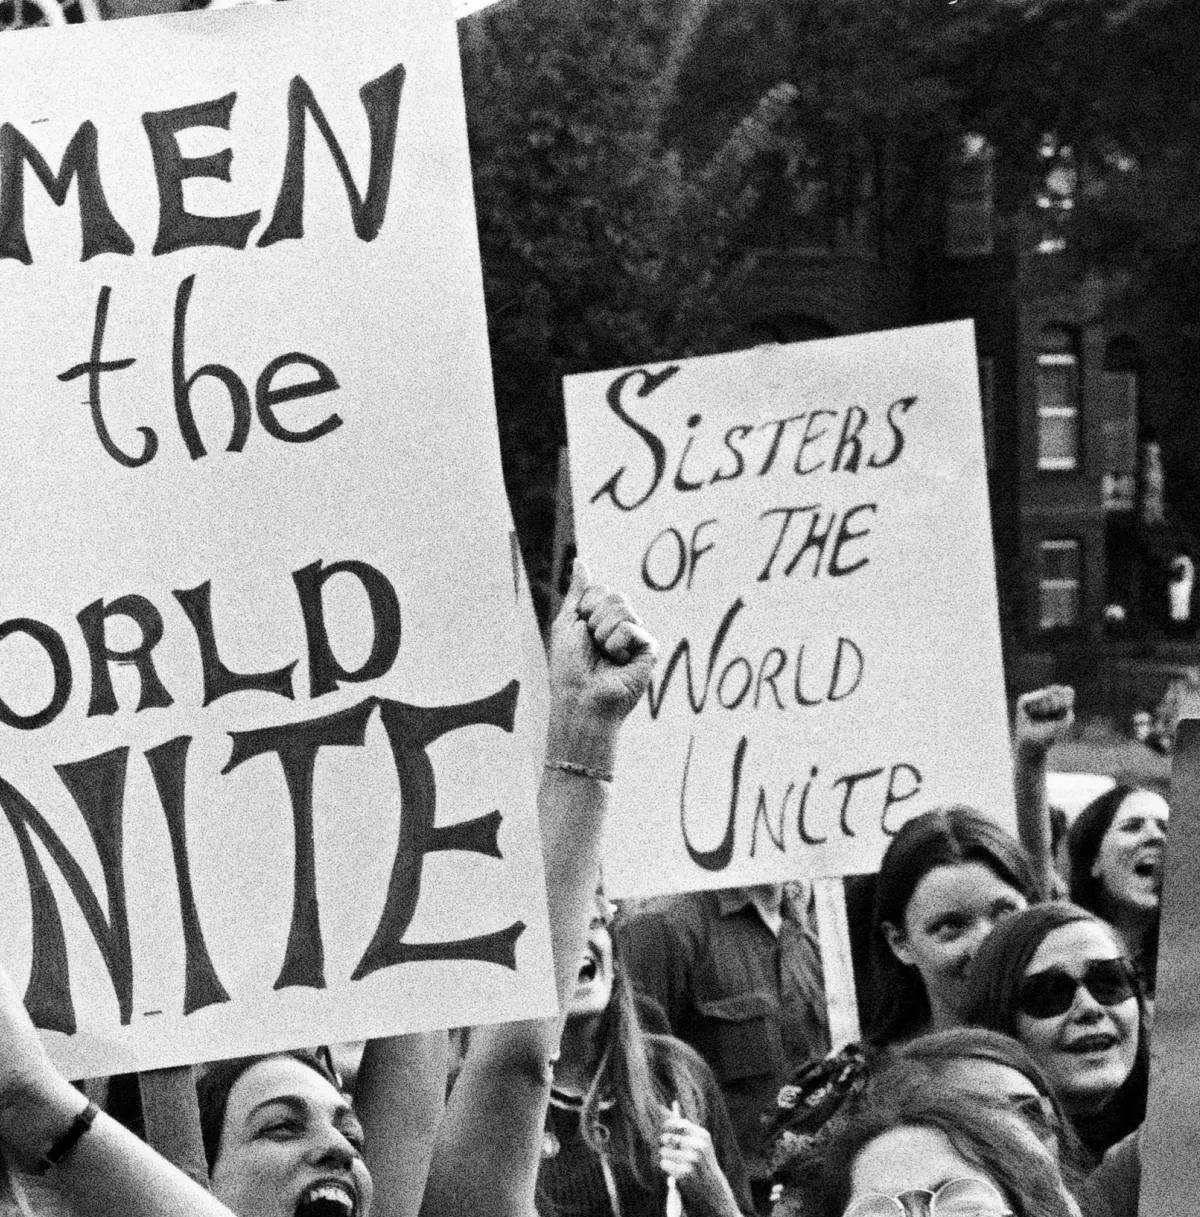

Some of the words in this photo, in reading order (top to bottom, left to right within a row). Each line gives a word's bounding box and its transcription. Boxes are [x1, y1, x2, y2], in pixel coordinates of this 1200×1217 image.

[57, 273, 344, 468] the
[641, 519, 719, 592] OF
[756, 503, 877, 582] THE
[646, 597, 864, 720] WORLD
